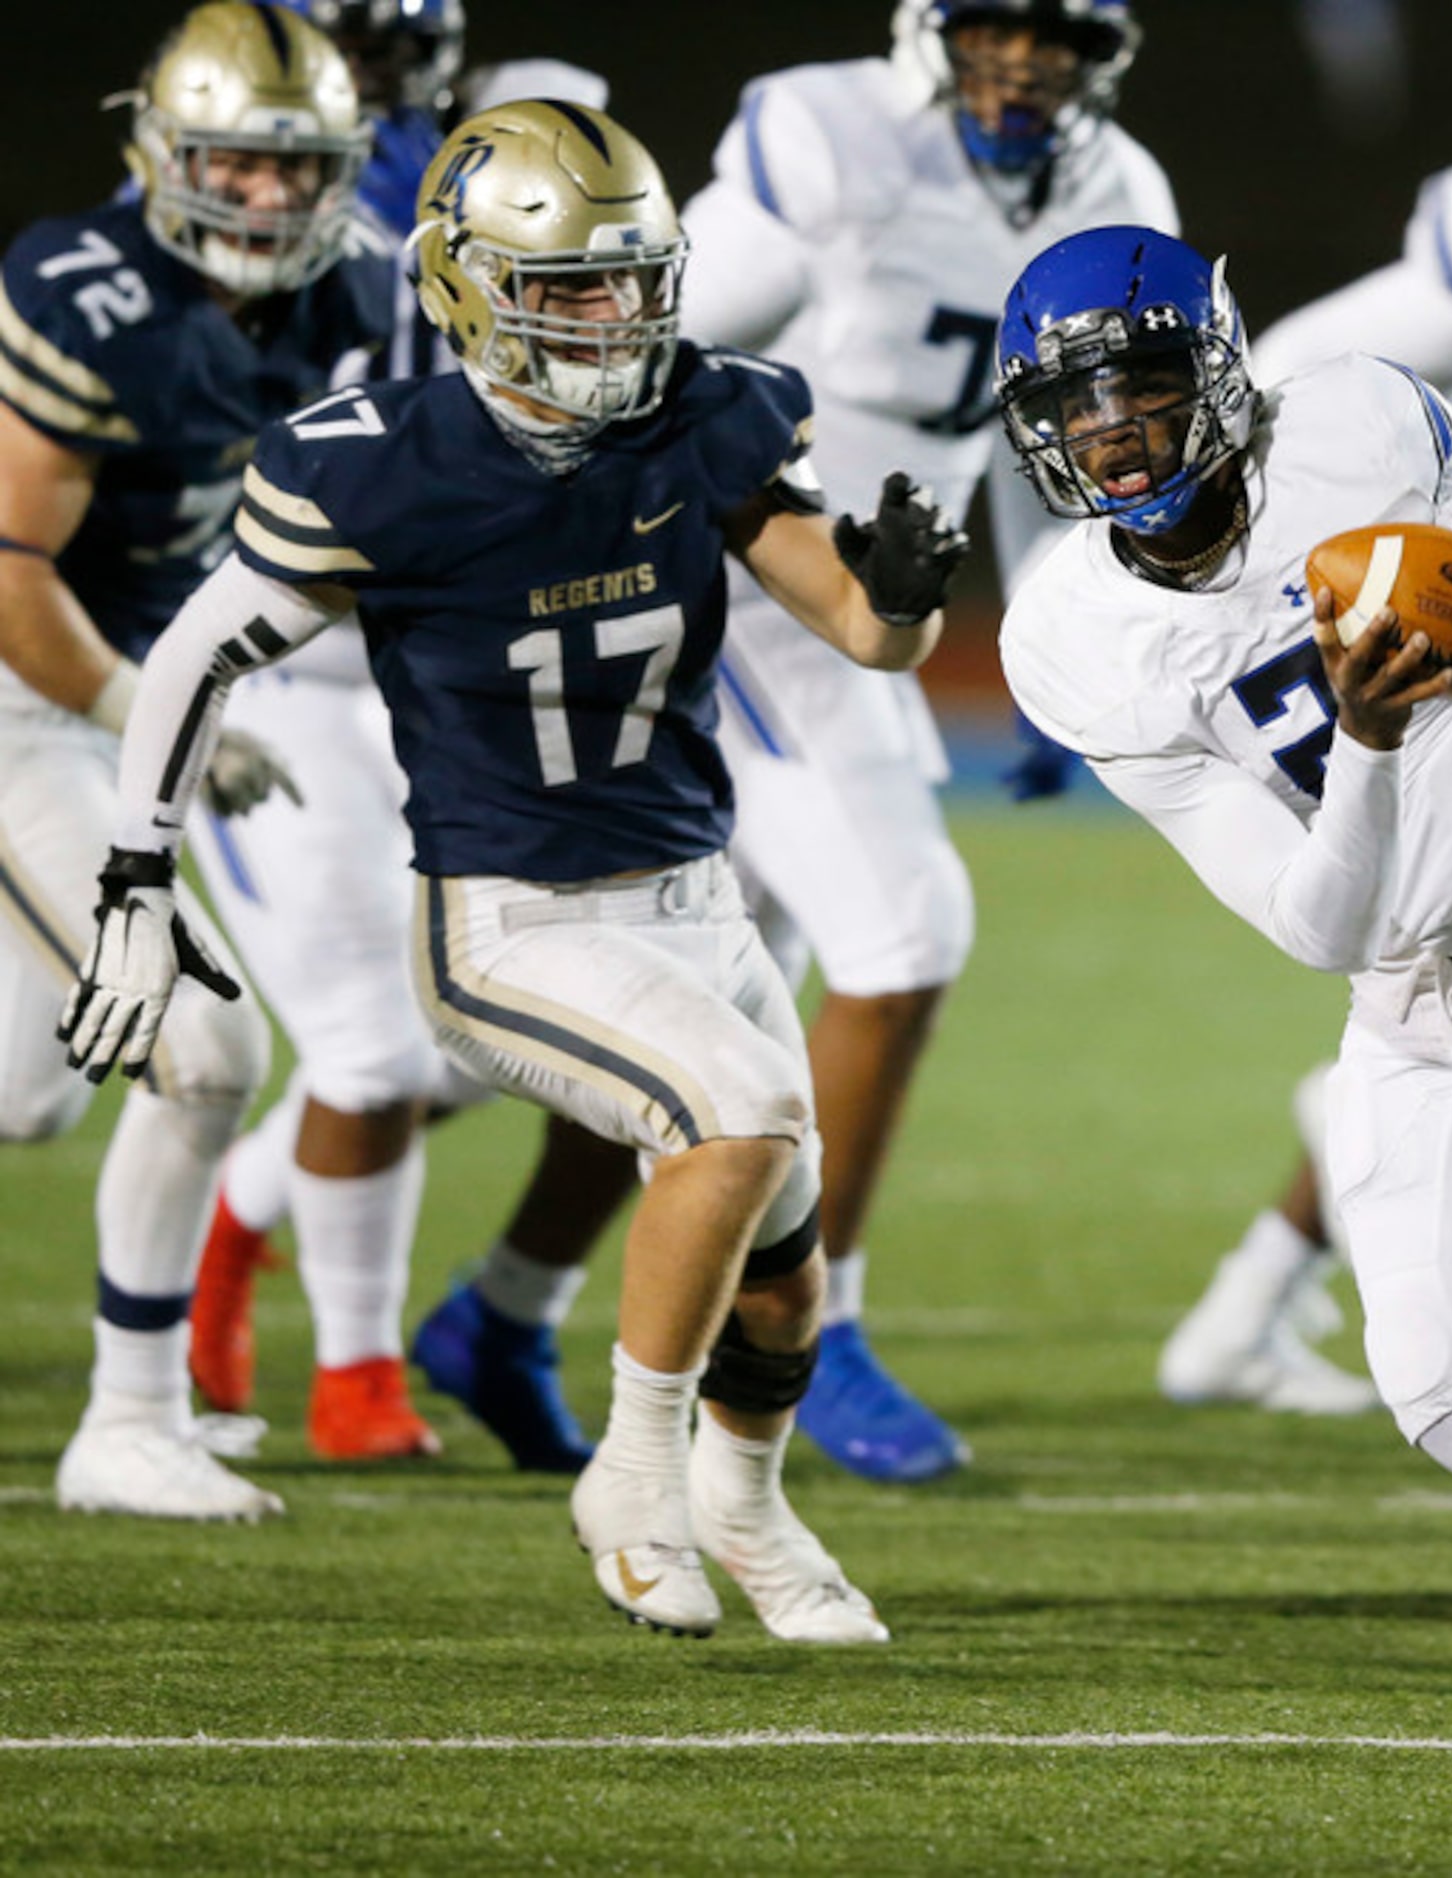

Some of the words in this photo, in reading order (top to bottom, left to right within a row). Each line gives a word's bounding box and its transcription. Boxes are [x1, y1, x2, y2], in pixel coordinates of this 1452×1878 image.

[35, 228, 152, 339] 72
[285, 386, 387, 440] 17
[529, 562, 658, 617] REGENTS
[507, 602, 686, 788] 17
